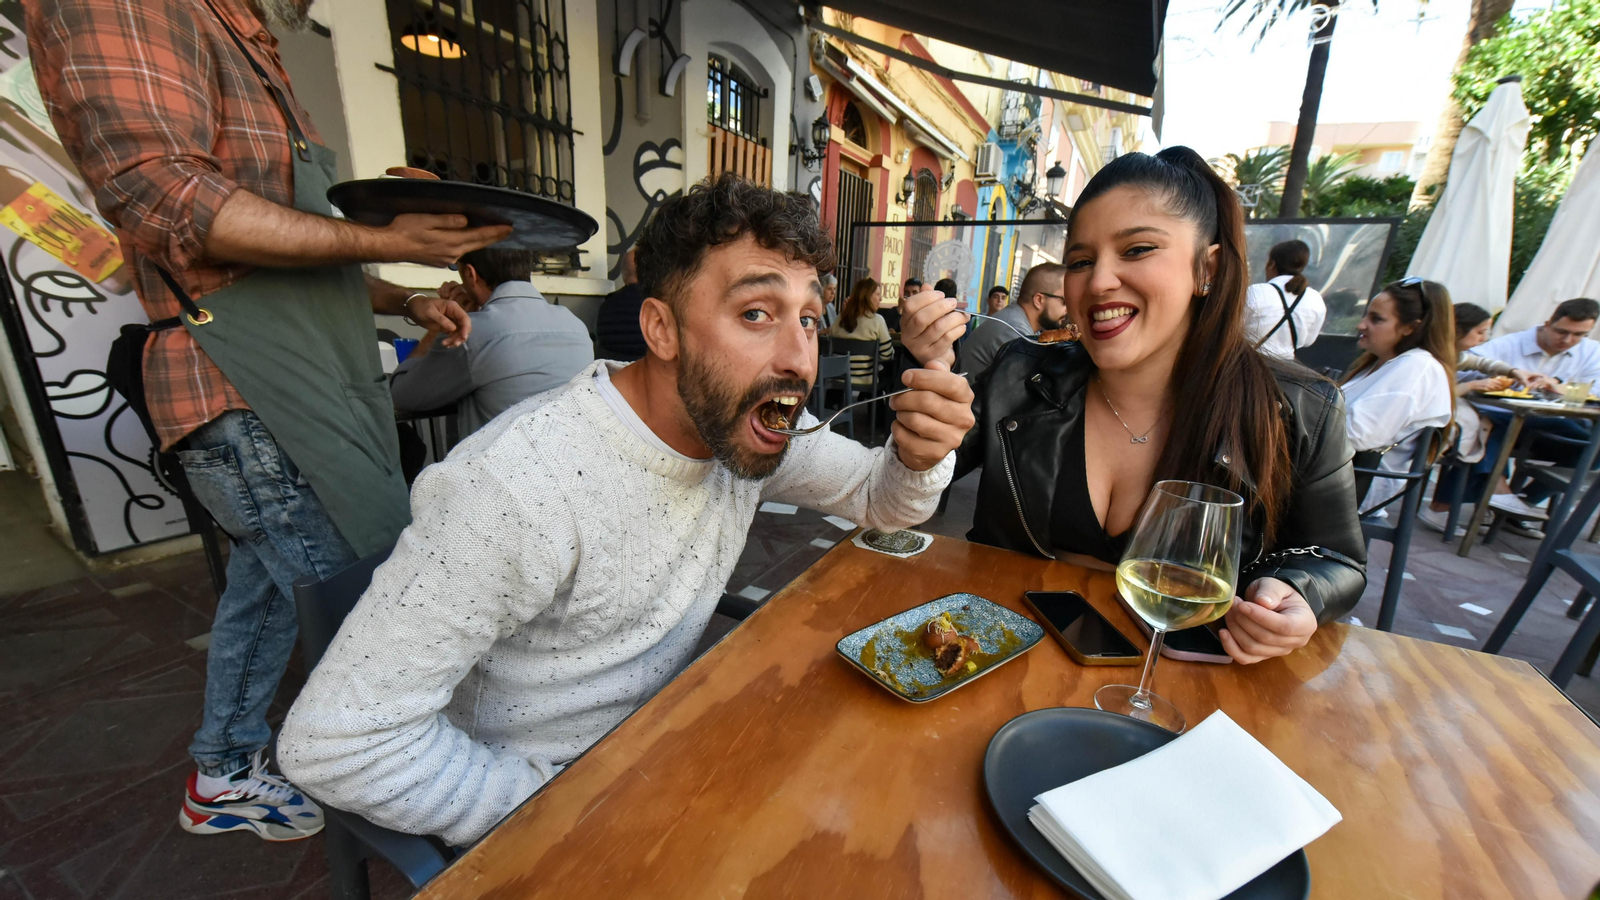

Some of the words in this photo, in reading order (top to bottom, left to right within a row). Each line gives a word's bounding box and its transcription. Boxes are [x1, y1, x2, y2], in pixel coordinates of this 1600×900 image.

[892, 213, 899, 232] EL
[883, 236, 904, 256] PATIO
[887, 260, 897, 278] DE
[881, 282, 900, 299] DIEGO
